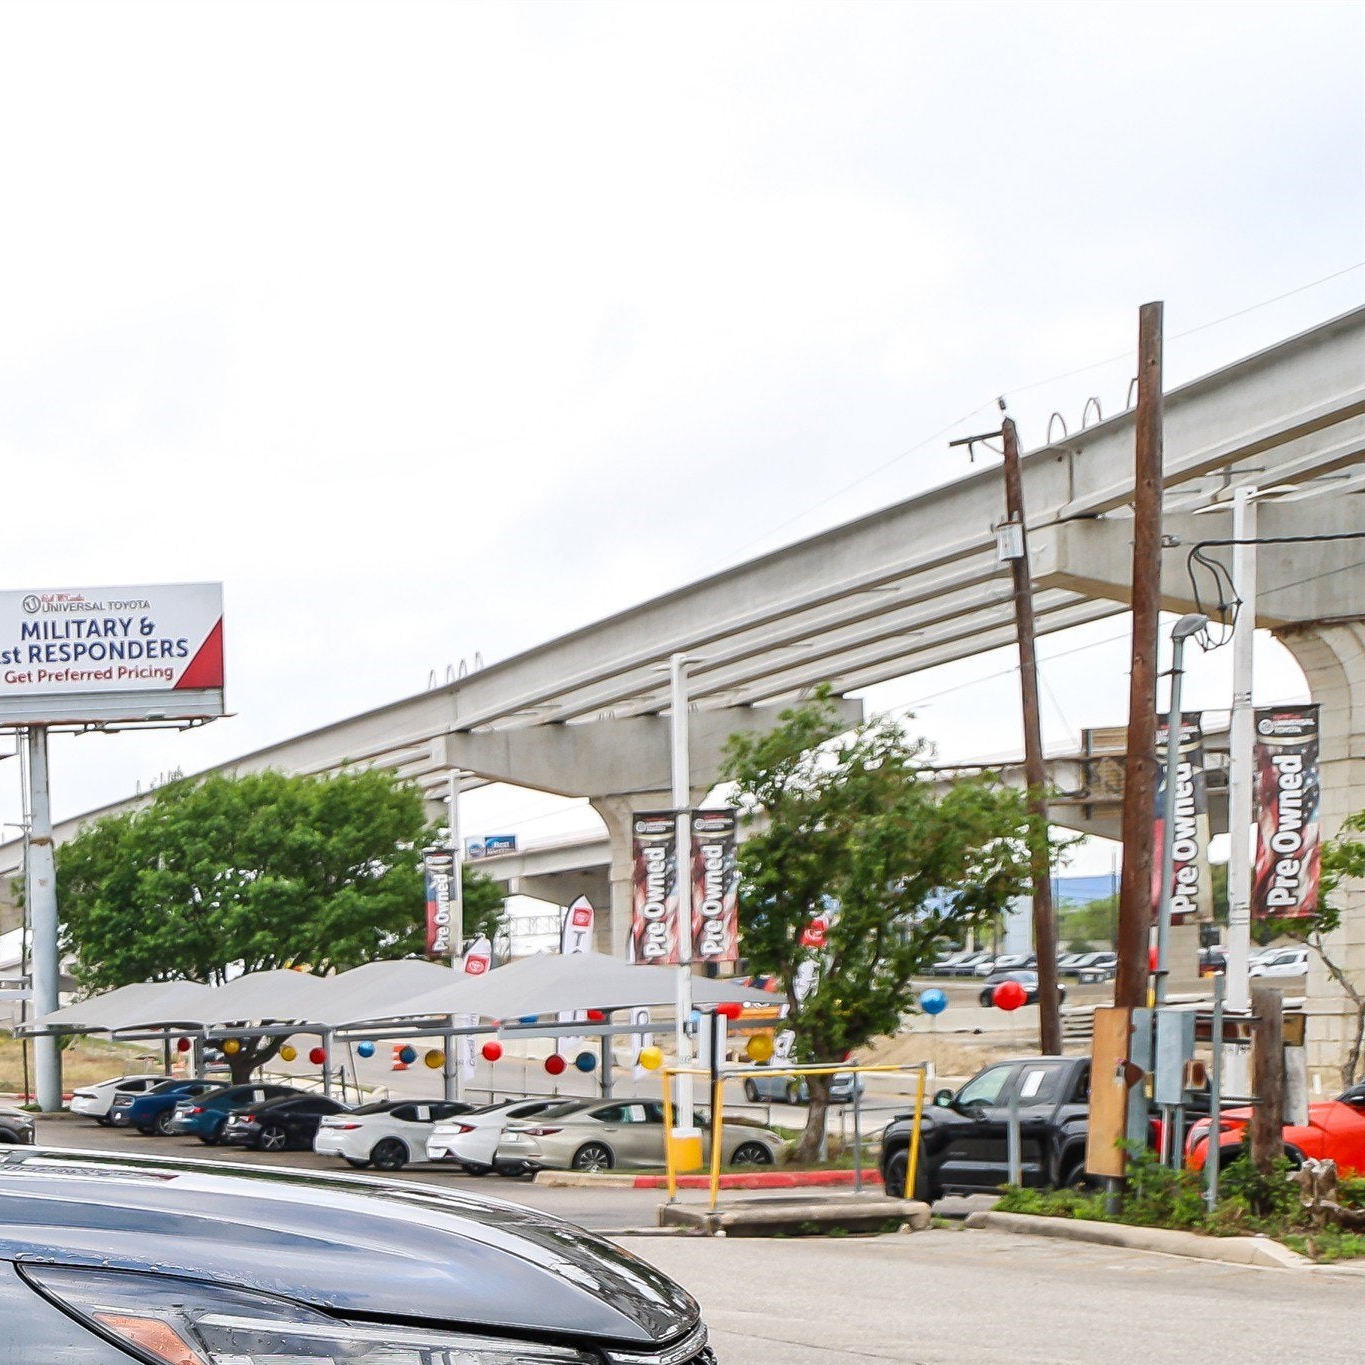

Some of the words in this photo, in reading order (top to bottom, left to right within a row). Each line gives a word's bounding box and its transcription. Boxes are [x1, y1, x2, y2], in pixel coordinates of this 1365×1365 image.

[42, 601, 106, 613] UNIVERSAL
[108, 600, 151, 611] TOYOTA
[21, 617, 133, 640] MILITARY
[140, 616, 156, 636] &
[28, 638, 189, 663] RESPONDERS
[4, 669, 33, 683] Get
[38, 665, 113, 682] Preferred
[119, 664, 174, 681] Pricing
[1271, 755, 1303, 853] Owned
[643, 847, 665, 918] Owned
[701, 845, 724, 916] Owned
[1170, 865, 1199, 913] Pre
[1266, 858, 1301, 906] Pre
[643, 922, 666, 957] Pre
[701, 920, 724, 955] Pre
